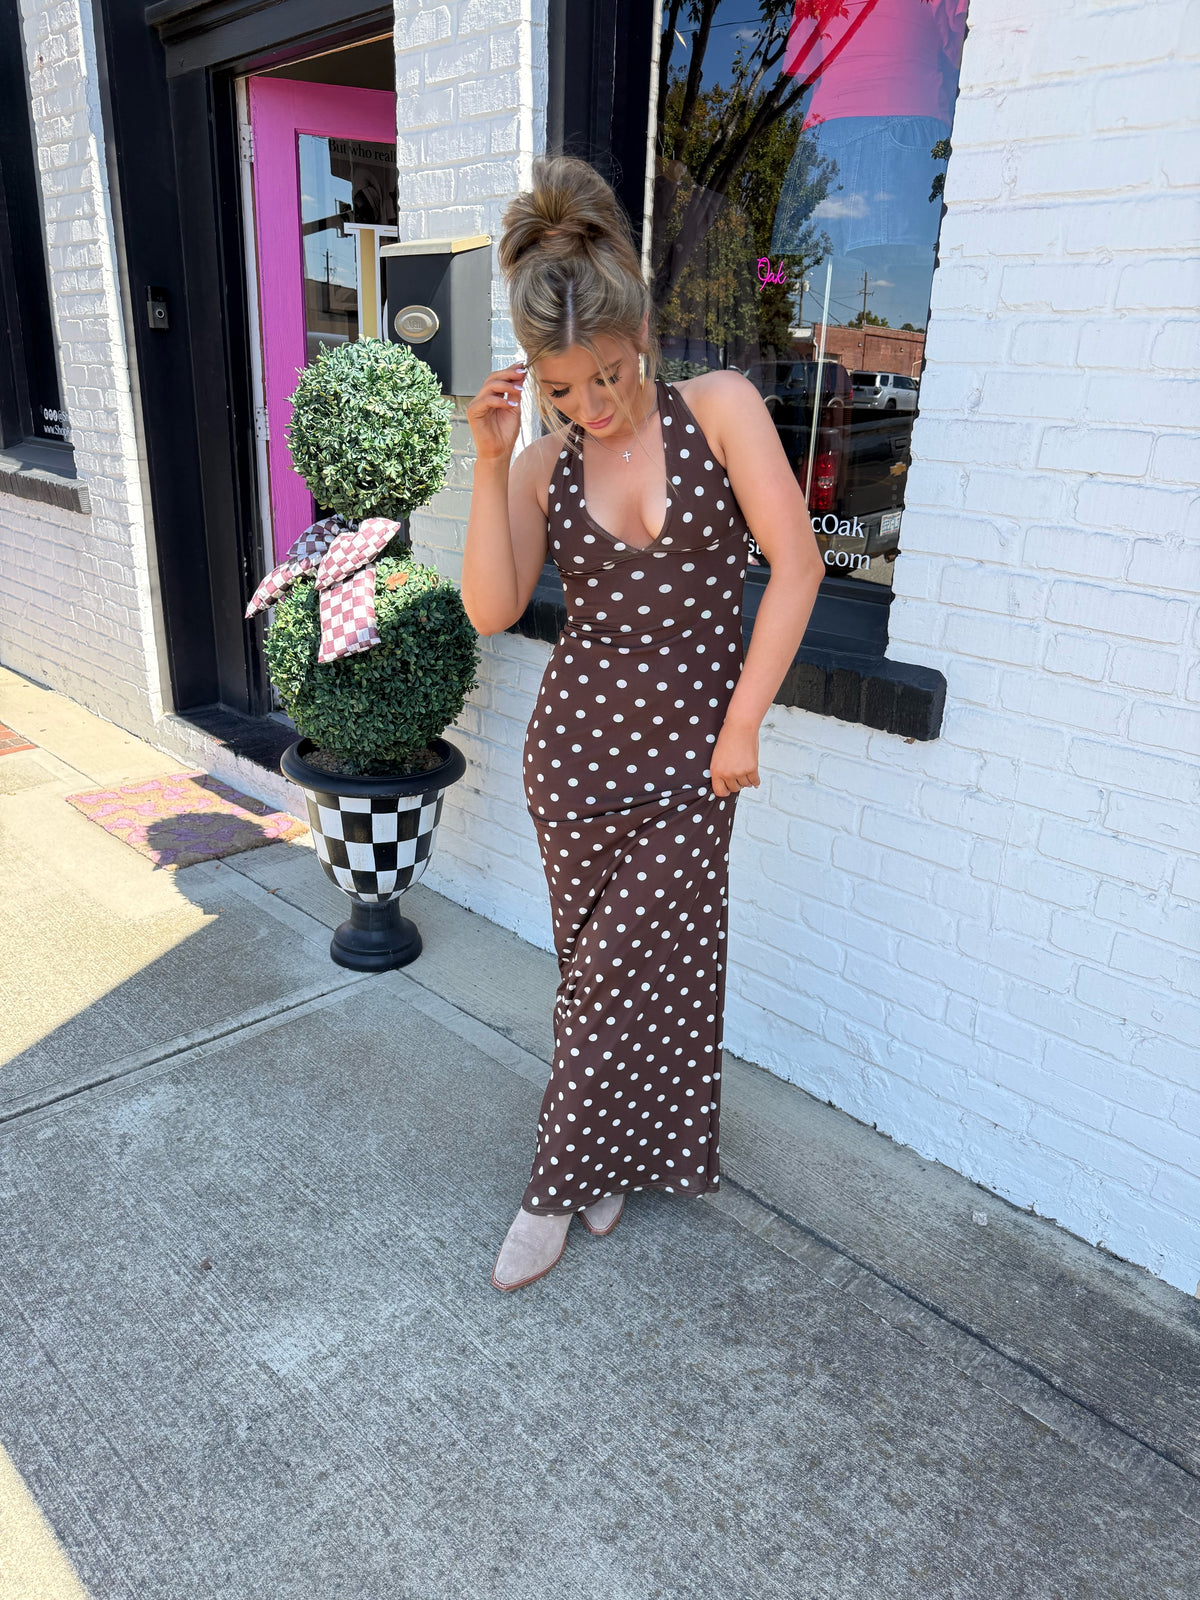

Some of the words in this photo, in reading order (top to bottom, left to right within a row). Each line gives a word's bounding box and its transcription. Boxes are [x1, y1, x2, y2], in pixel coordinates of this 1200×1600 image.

[329, 139, 347, 154] But
[351, 144, 372, 159] who
[757, 257, 787, 292] Oak
[809, 512, 865, 538] cOak
